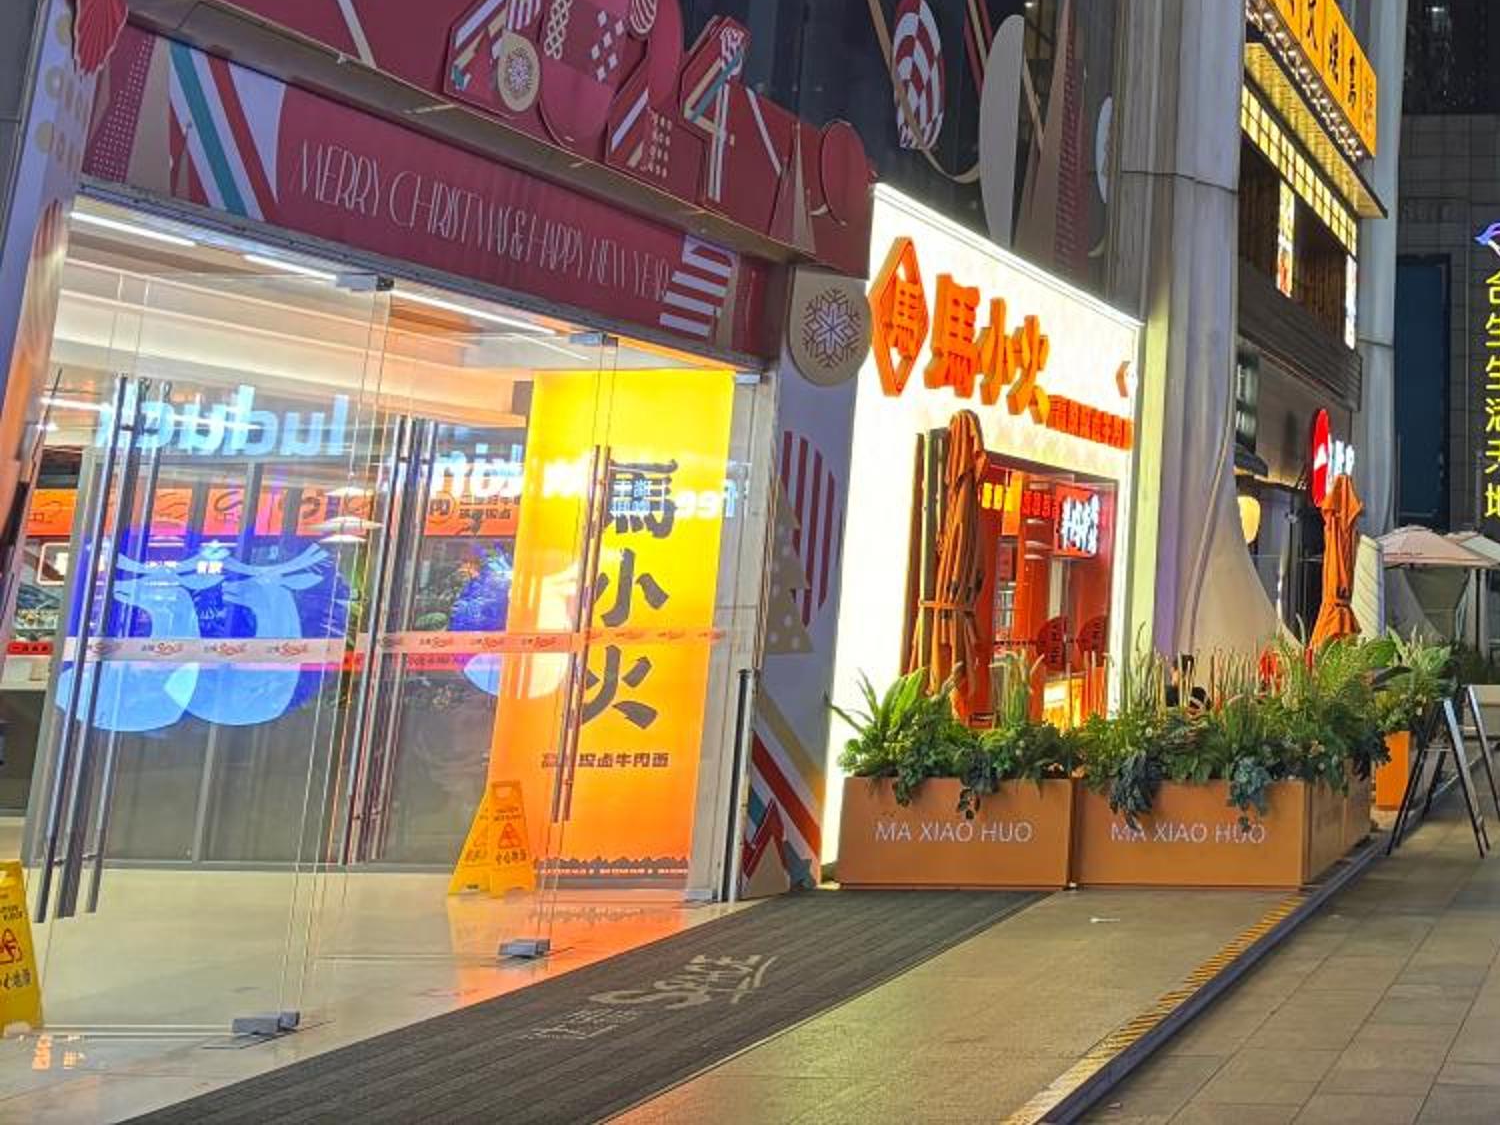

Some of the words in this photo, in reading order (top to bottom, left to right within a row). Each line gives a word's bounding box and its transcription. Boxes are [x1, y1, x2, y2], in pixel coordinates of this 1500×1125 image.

[301, 139, 379, 217] MERRY
[874, 821, 912, 843] MA
[917, 821, 974, 843] XIAO
[980, 821, 1033, 843] HUO
[1110, 822, 1146, 843] MA
[1152, 821, 1208, 843] XIAO
[1215, 821, 1267, 844] HUO
